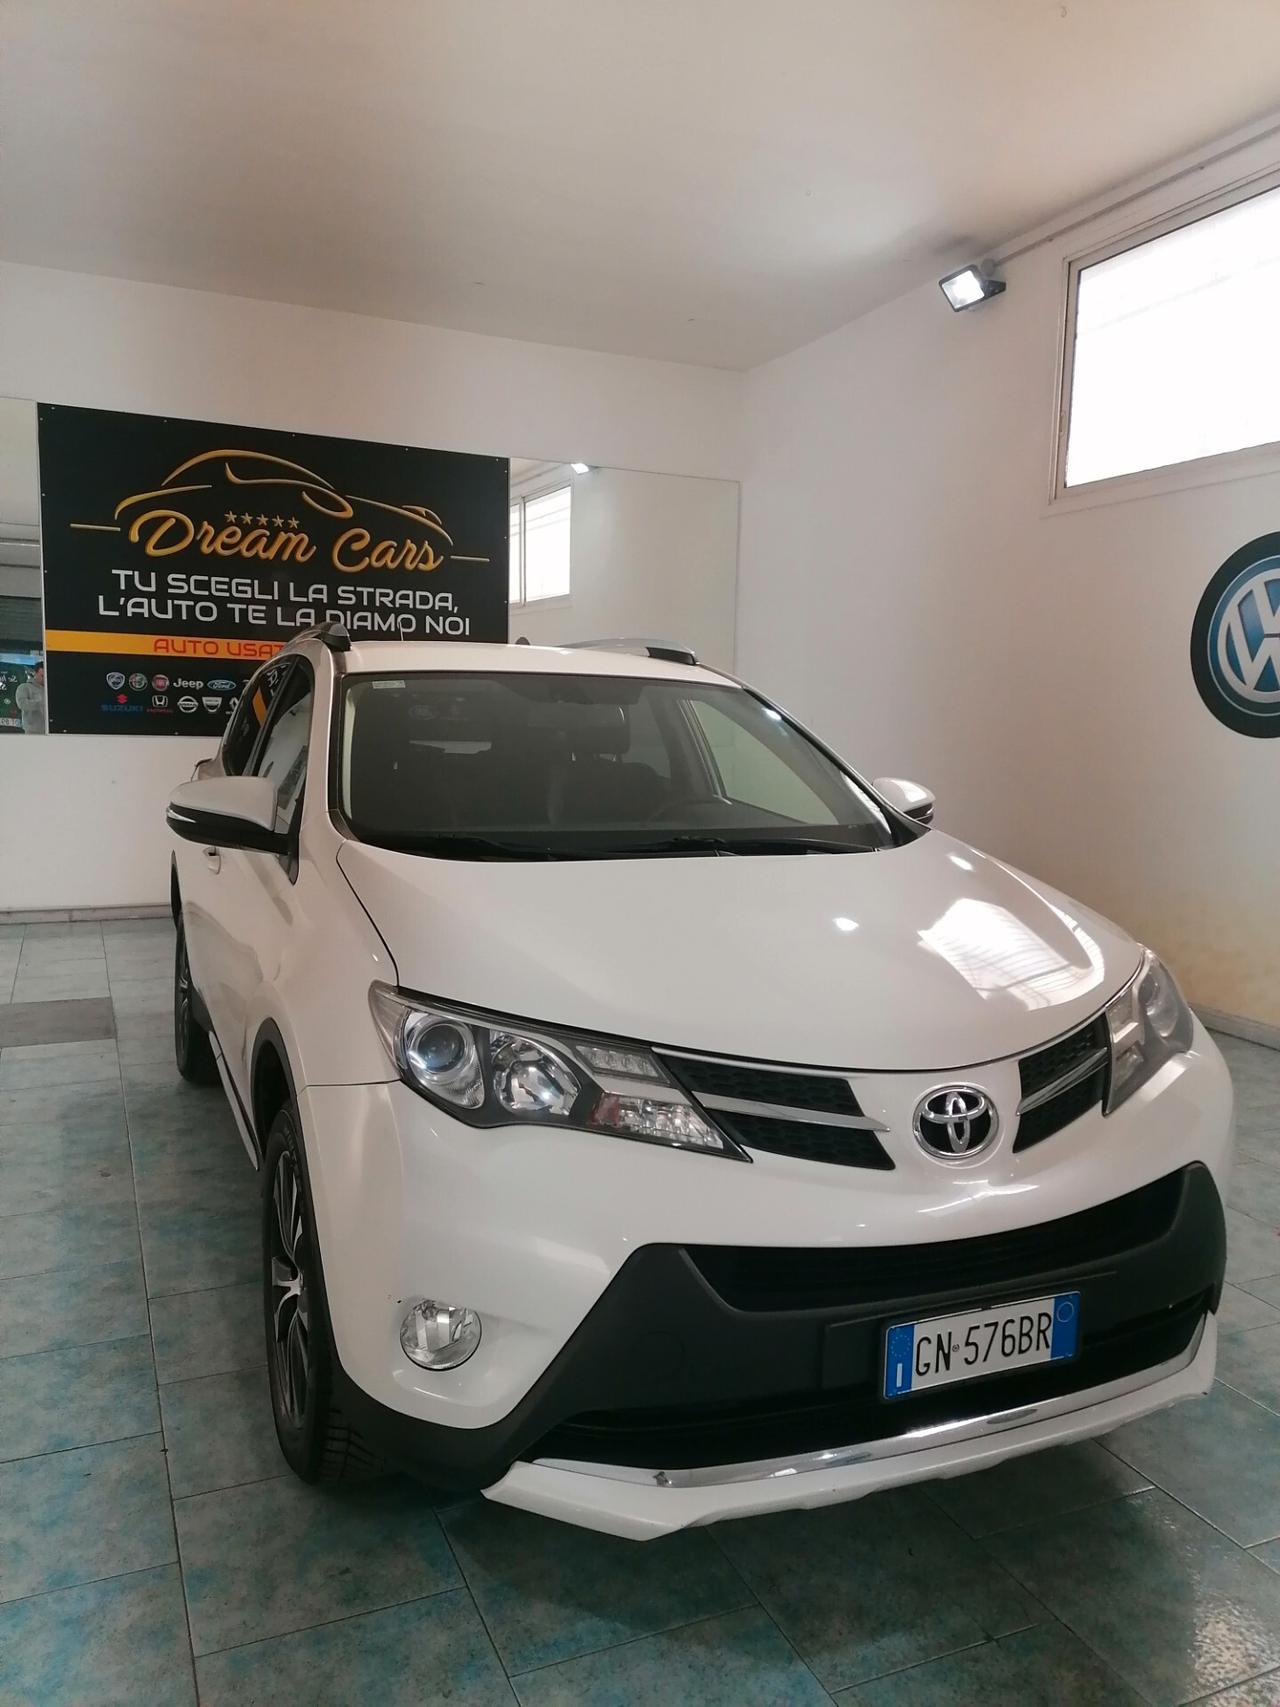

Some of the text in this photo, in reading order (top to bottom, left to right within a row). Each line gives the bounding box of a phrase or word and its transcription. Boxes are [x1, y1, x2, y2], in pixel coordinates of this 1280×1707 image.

[128, 509, 444, 573] Dream Cars
[111, 569, 459, 613] TU SCEGLI LA STRADA,
[98, 595, 470, 636] L'AUTO TE LA DIAMO NOI
[153, 638, 219, 656] AUTO
[172, 678, 204, 691] Jeep
[915, 1331, 952, 1376] GN
[963, 1312, 1052, 1365] 576BR
